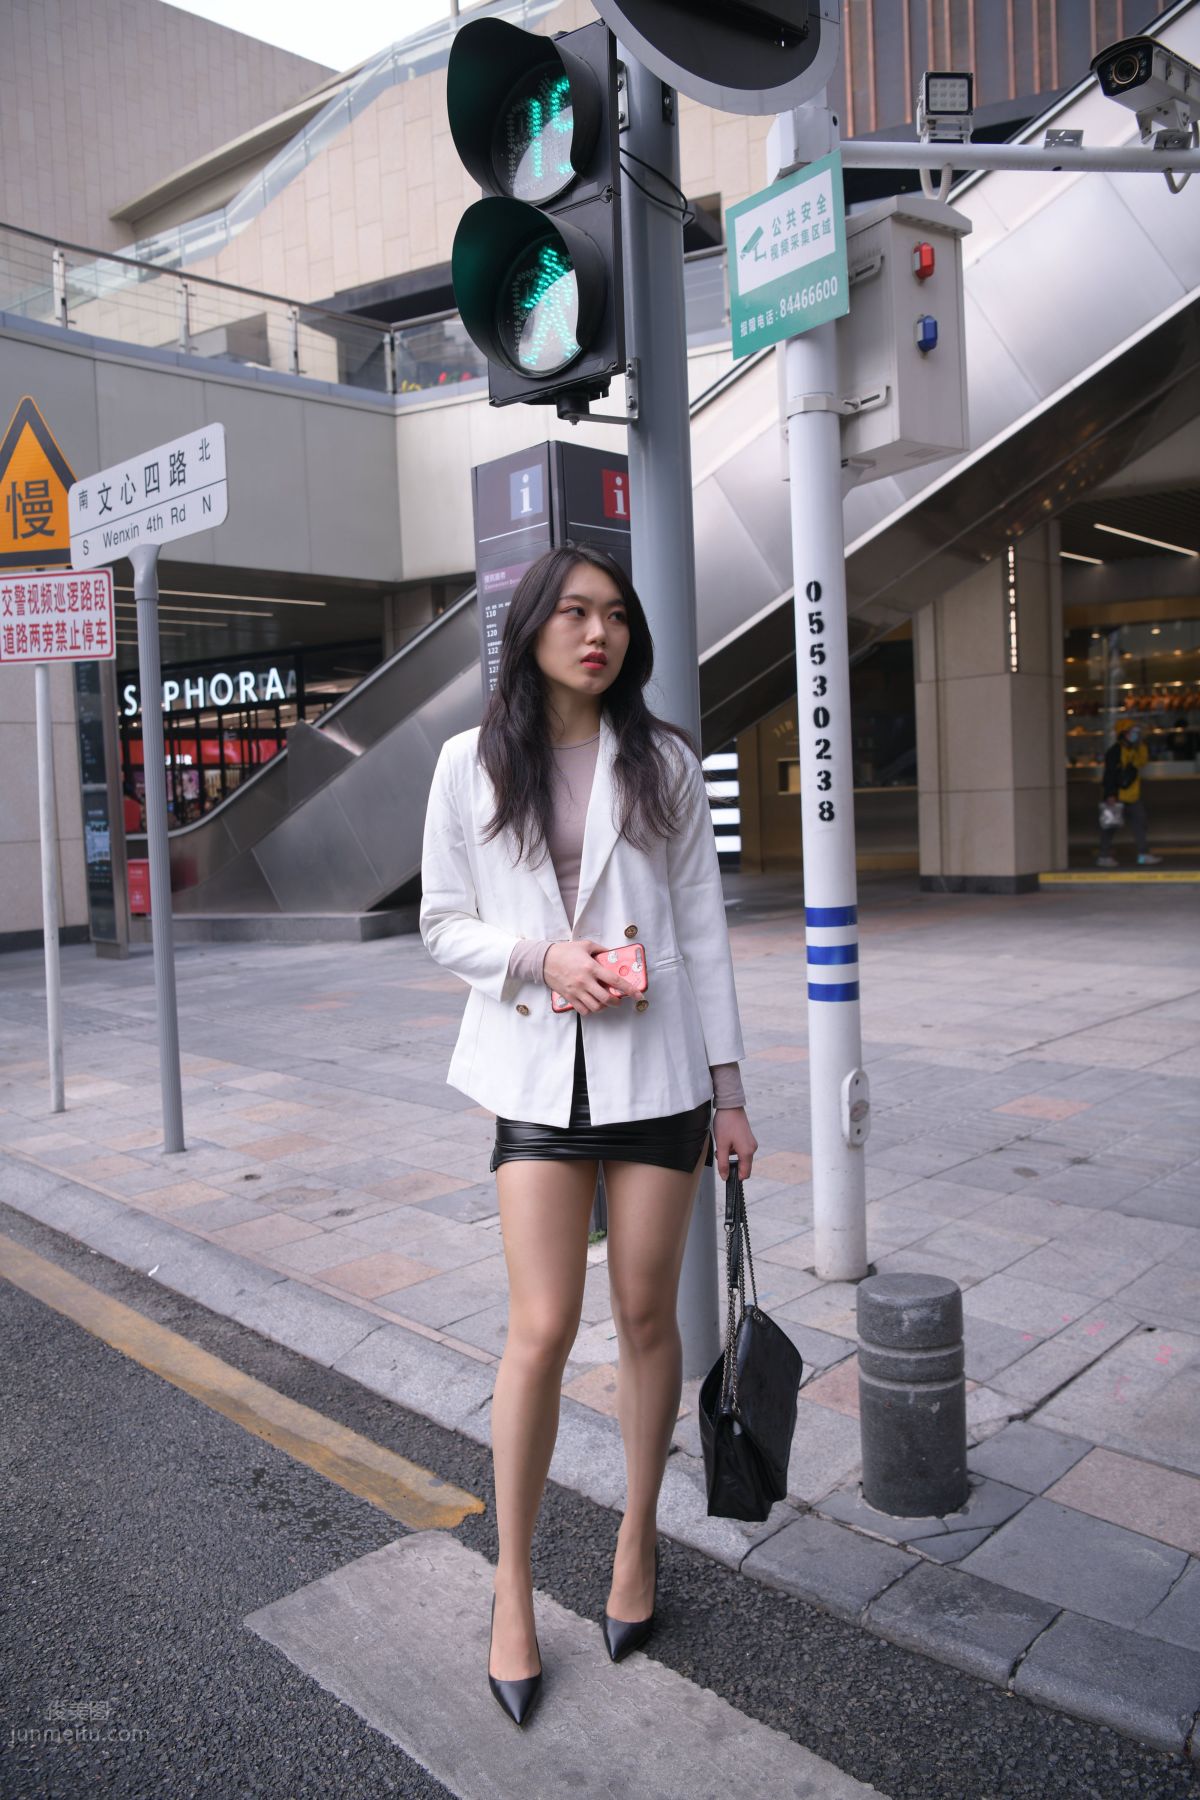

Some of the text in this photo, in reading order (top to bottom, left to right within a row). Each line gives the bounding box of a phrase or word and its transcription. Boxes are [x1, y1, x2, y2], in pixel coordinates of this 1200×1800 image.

[771, 193, 827, 237] 公共安全
[770, 217, 832, 262] 视频采集区域
[78, 437, 211, 515] 南 文心四路 北
[5, 478, 55, 540] 慢
[83, 494, 212, 556] S Wenxin 4th Rd N
[1, 579, 106, 617] 交警视频巡逻路段
[485, 609, 497, 618] 110
[3, 618, 108, 655] 道路两旁禁止停车
[486, 629, 498, 638] 120
[487, 646, 499, 655] 122
[123, 667, 286, 717] SPHORA
[805, 580, 836, 822] 05530238
